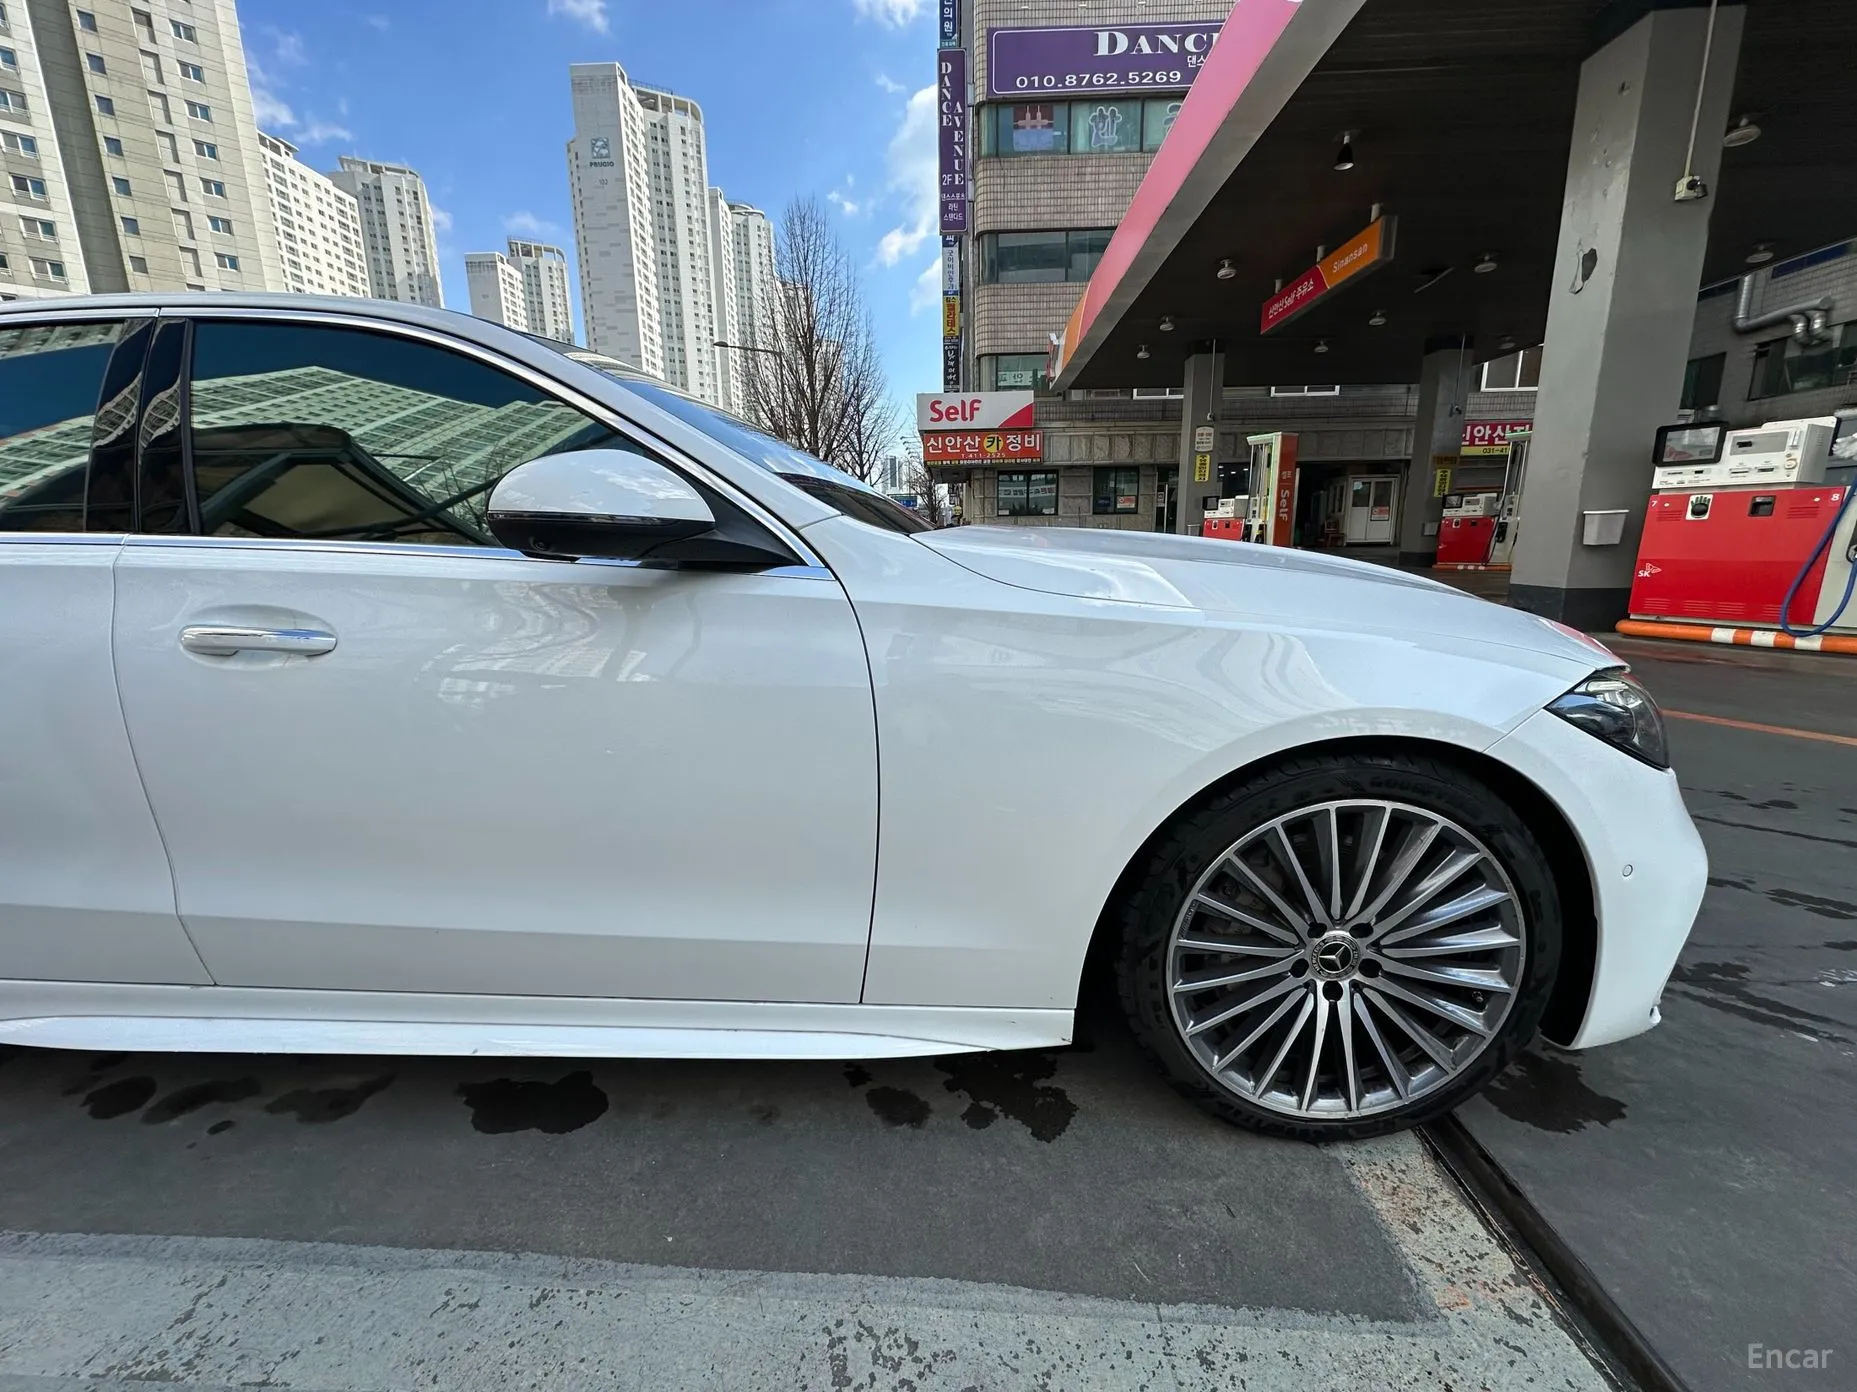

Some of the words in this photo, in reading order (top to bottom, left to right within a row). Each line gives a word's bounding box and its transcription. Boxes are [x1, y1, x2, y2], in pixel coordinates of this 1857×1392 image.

[1016, 70, 1182, 88] 010.8762.5269
[941, 62, 952, 127] DANCE
[953, 101, 964, 185] AVENUE
[942, 173, 953, 186] 2F
[1332, 243, 1369, 273] Sinansan
[929, 399, 982, 422] Self
[927, 434, 1040, 453] 신안산카정비
[1279, 489, 1290, 522] Self
[1637, 569, 1651, 578] SK
